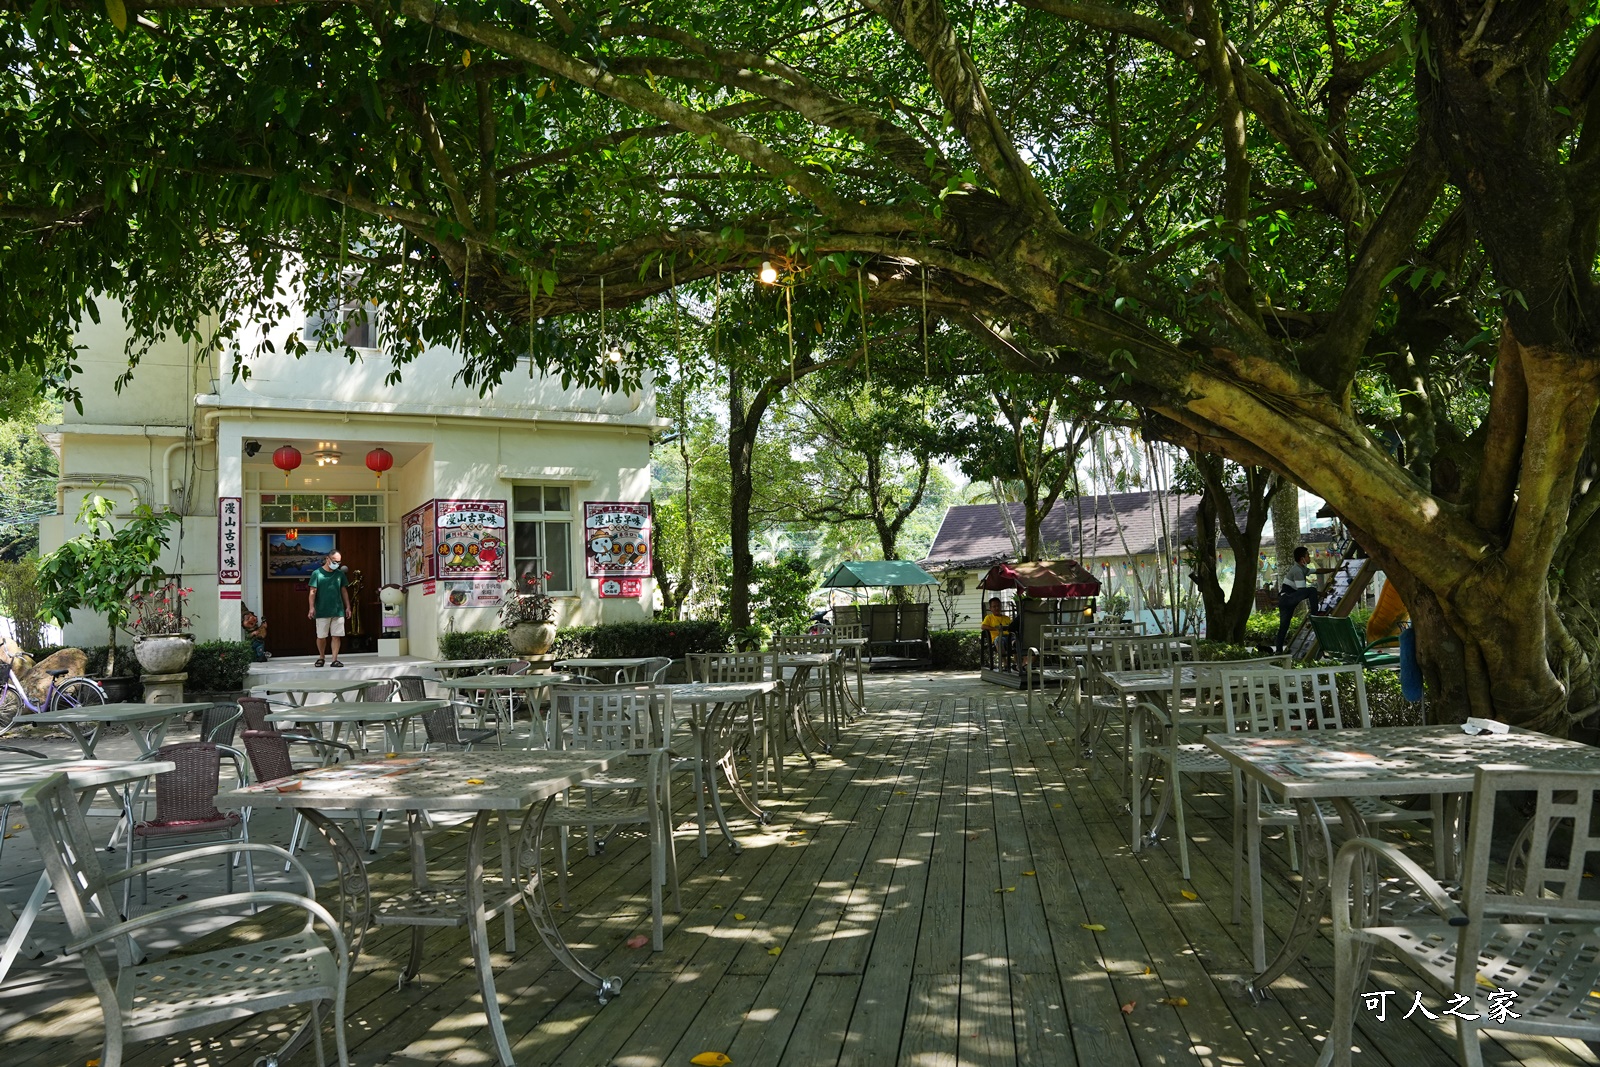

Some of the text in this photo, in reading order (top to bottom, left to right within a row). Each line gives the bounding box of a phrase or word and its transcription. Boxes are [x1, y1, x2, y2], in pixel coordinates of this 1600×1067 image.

[446, 512, 497, 525] 漫山古早味
[595, 514, 641, 526] 漫山古早味
[224, 502, 236, 568] 漫山古早味
